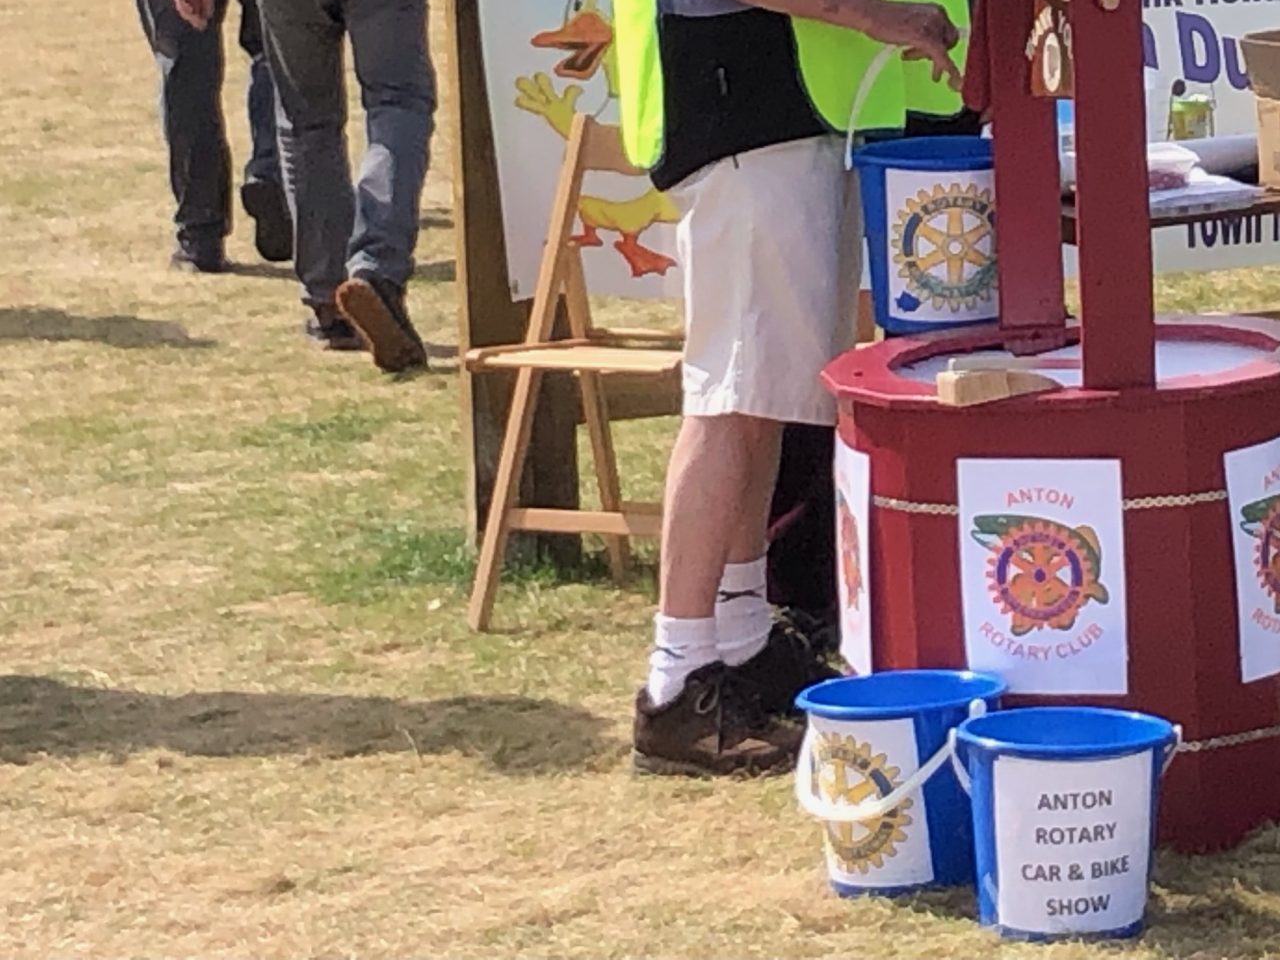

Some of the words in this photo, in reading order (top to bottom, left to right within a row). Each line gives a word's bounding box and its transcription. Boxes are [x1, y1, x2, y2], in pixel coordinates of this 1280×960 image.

[1006, 487, 1075, 510] ANTON
[978, 621, 1052, 661] ROTARY
[1055, 622, 1104, 660] CLUB
[1037, 789, 1113, 811] ANTON
[1035, 821, 1118, 846] ROTARY
[1021, 863, 1062, 882] CAR
[1067, 863, 1085, 881] &
[1091, 854, 1130, 880] BIKE
[1046, 893, 1111, 916] SHOW
